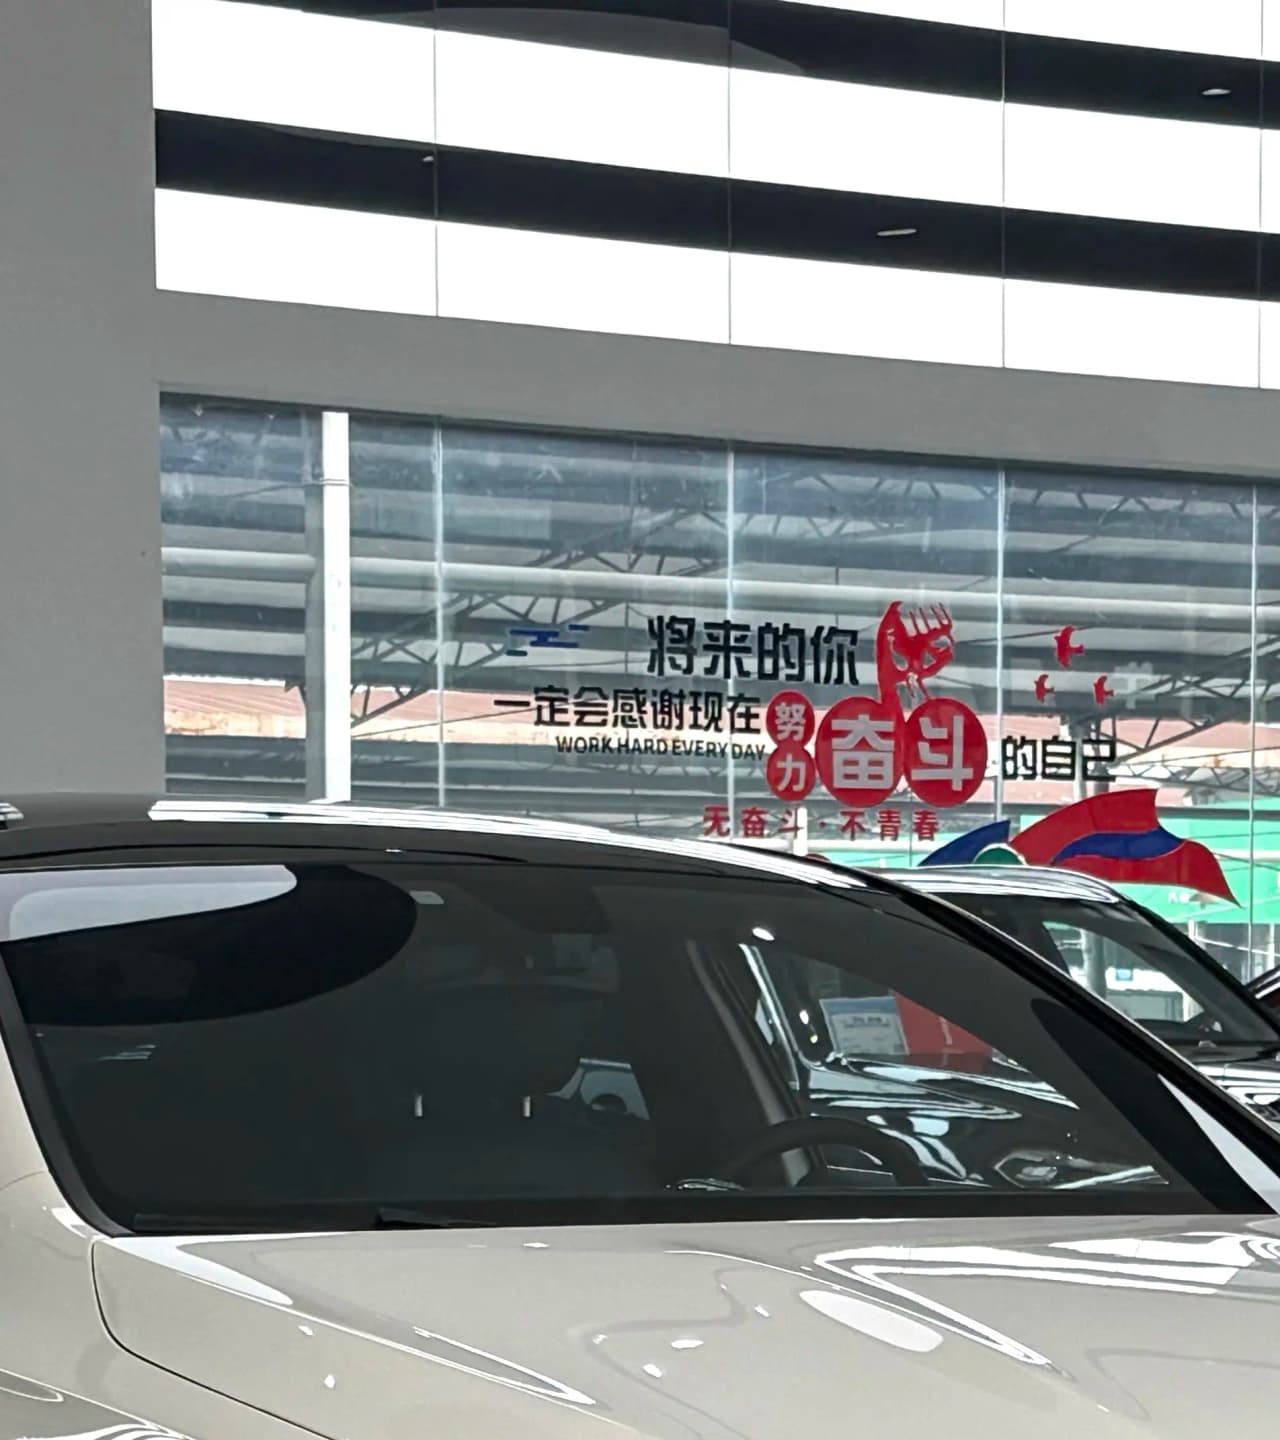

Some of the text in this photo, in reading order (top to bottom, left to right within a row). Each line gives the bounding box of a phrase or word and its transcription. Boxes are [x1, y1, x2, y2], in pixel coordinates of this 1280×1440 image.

[646, 615, 859, 687] 将来的你
[556, 736, 766, 762] WORK HARD EVERY DAY
